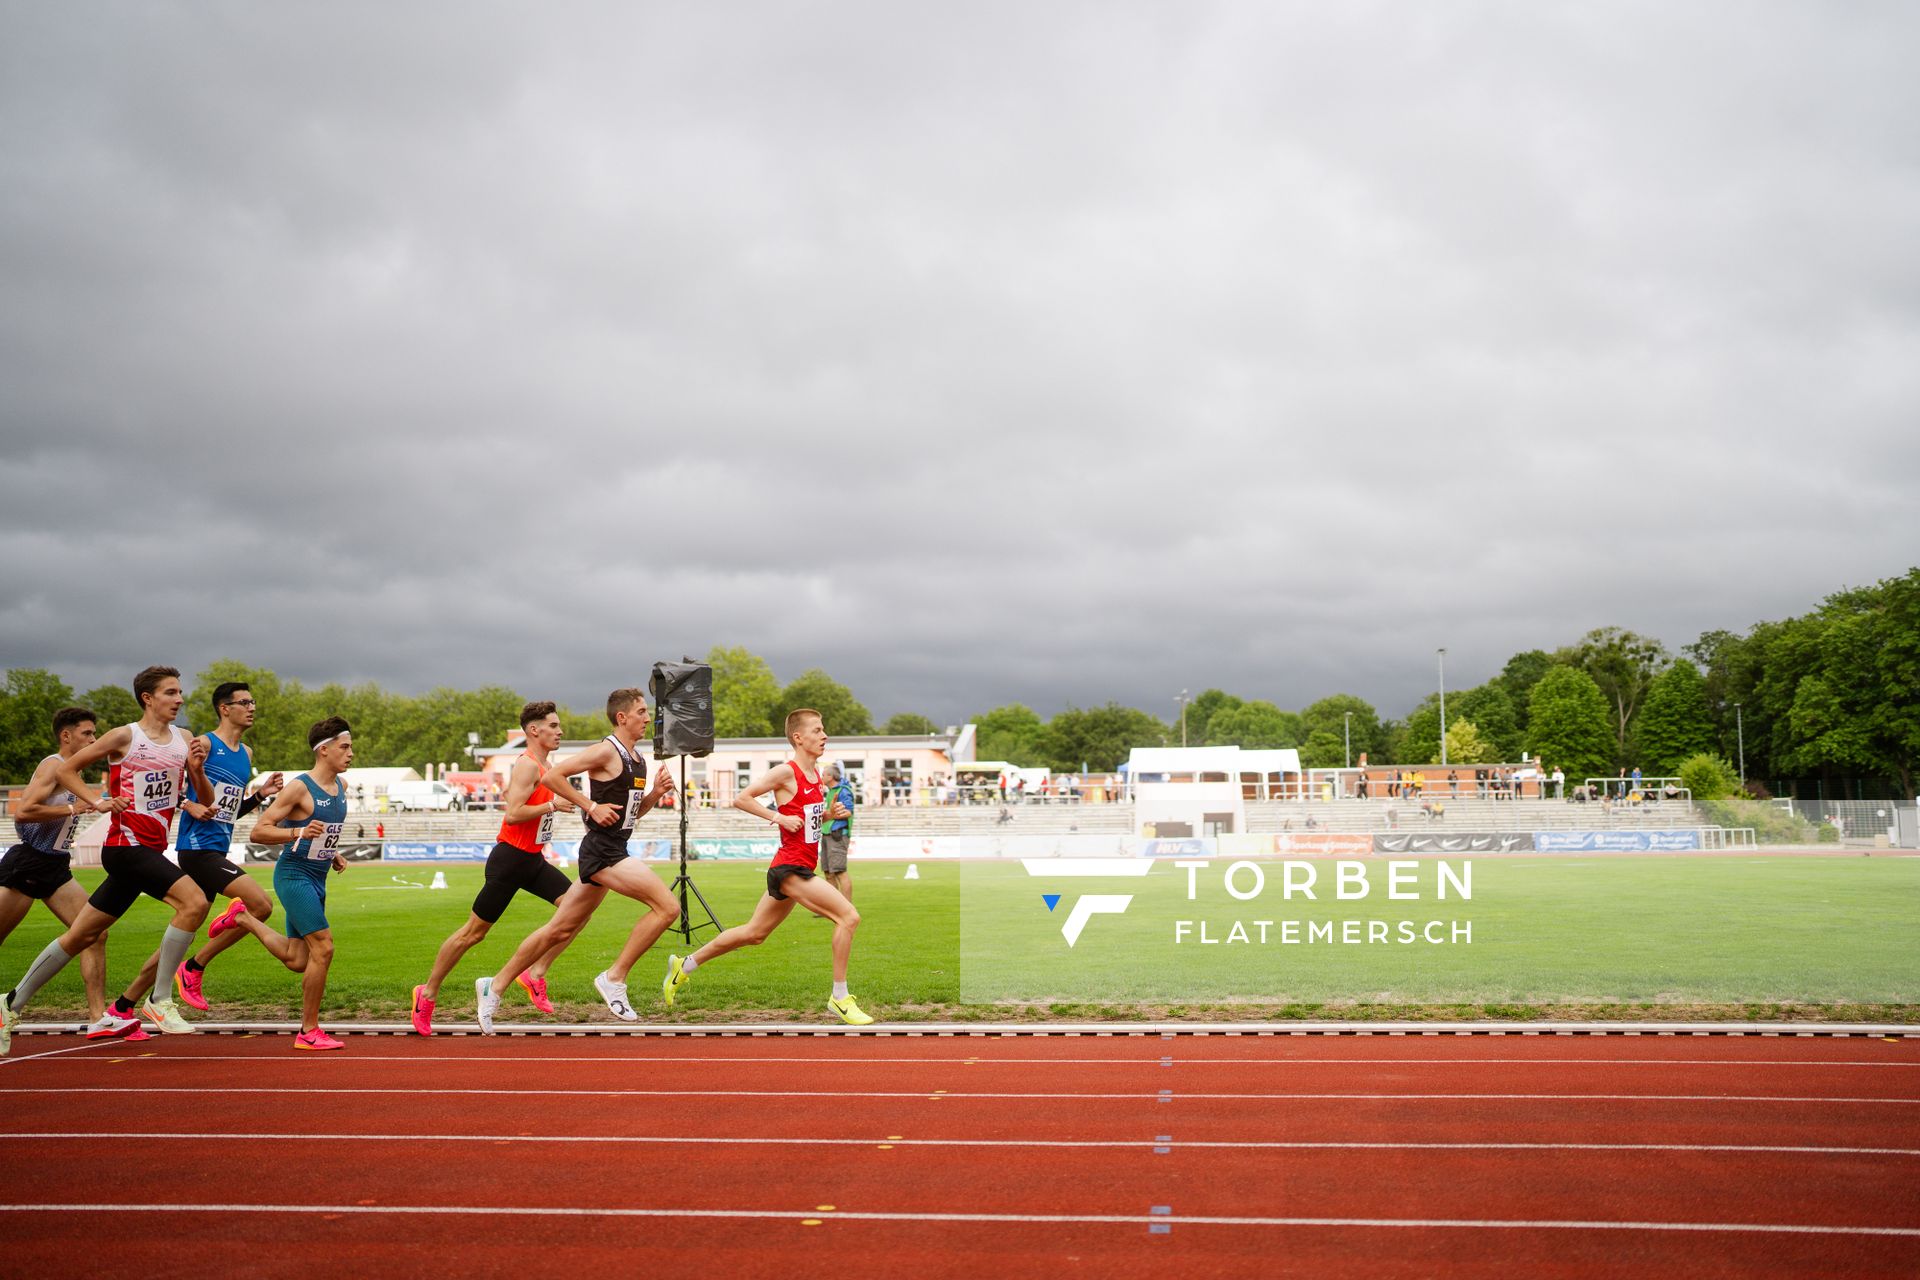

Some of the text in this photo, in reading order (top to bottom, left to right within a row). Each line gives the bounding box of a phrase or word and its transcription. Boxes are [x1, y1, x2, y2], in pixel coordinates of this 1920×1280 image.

[145, 770, 168, 783] GLS
[143, 781, 172, 799] 442
[223, 786, 240, 797] GLS
[218, 795, 239, 812] 443
[326, 824, 343, 834] GLS
[324, 834, 340, 849] 62
